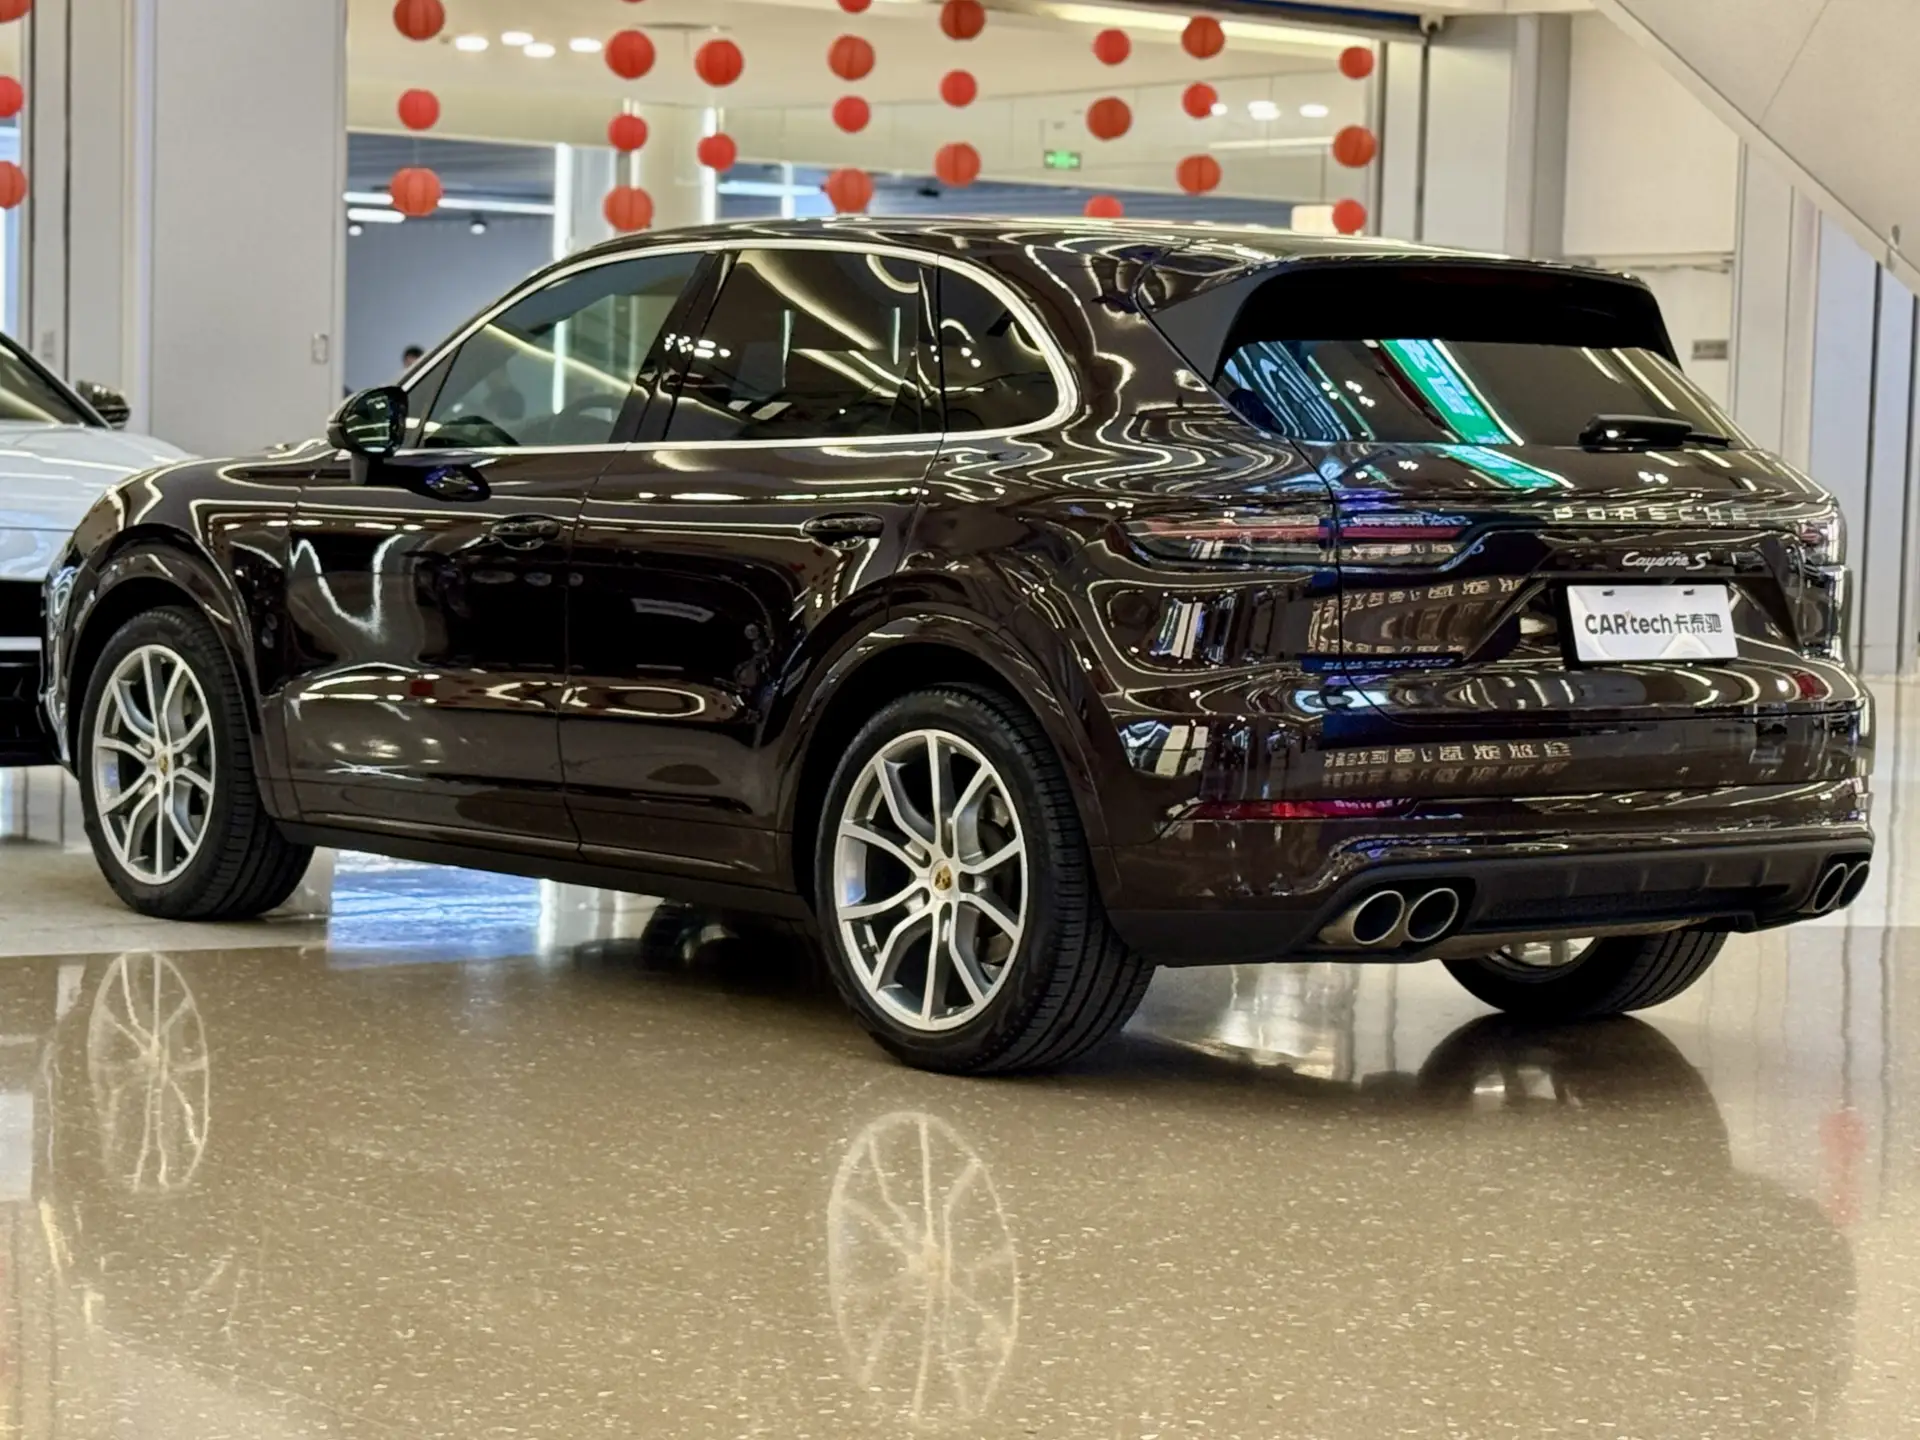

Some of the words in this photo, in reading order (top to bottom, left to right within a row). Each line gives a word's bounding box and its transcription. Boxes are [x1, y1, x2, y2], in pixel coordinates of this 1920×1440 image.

[1553, 506, 1748, 521] PORSCHE
[1621, 551, 1689, 573] Cayenne
[1686, 551, 1712, 571] S
